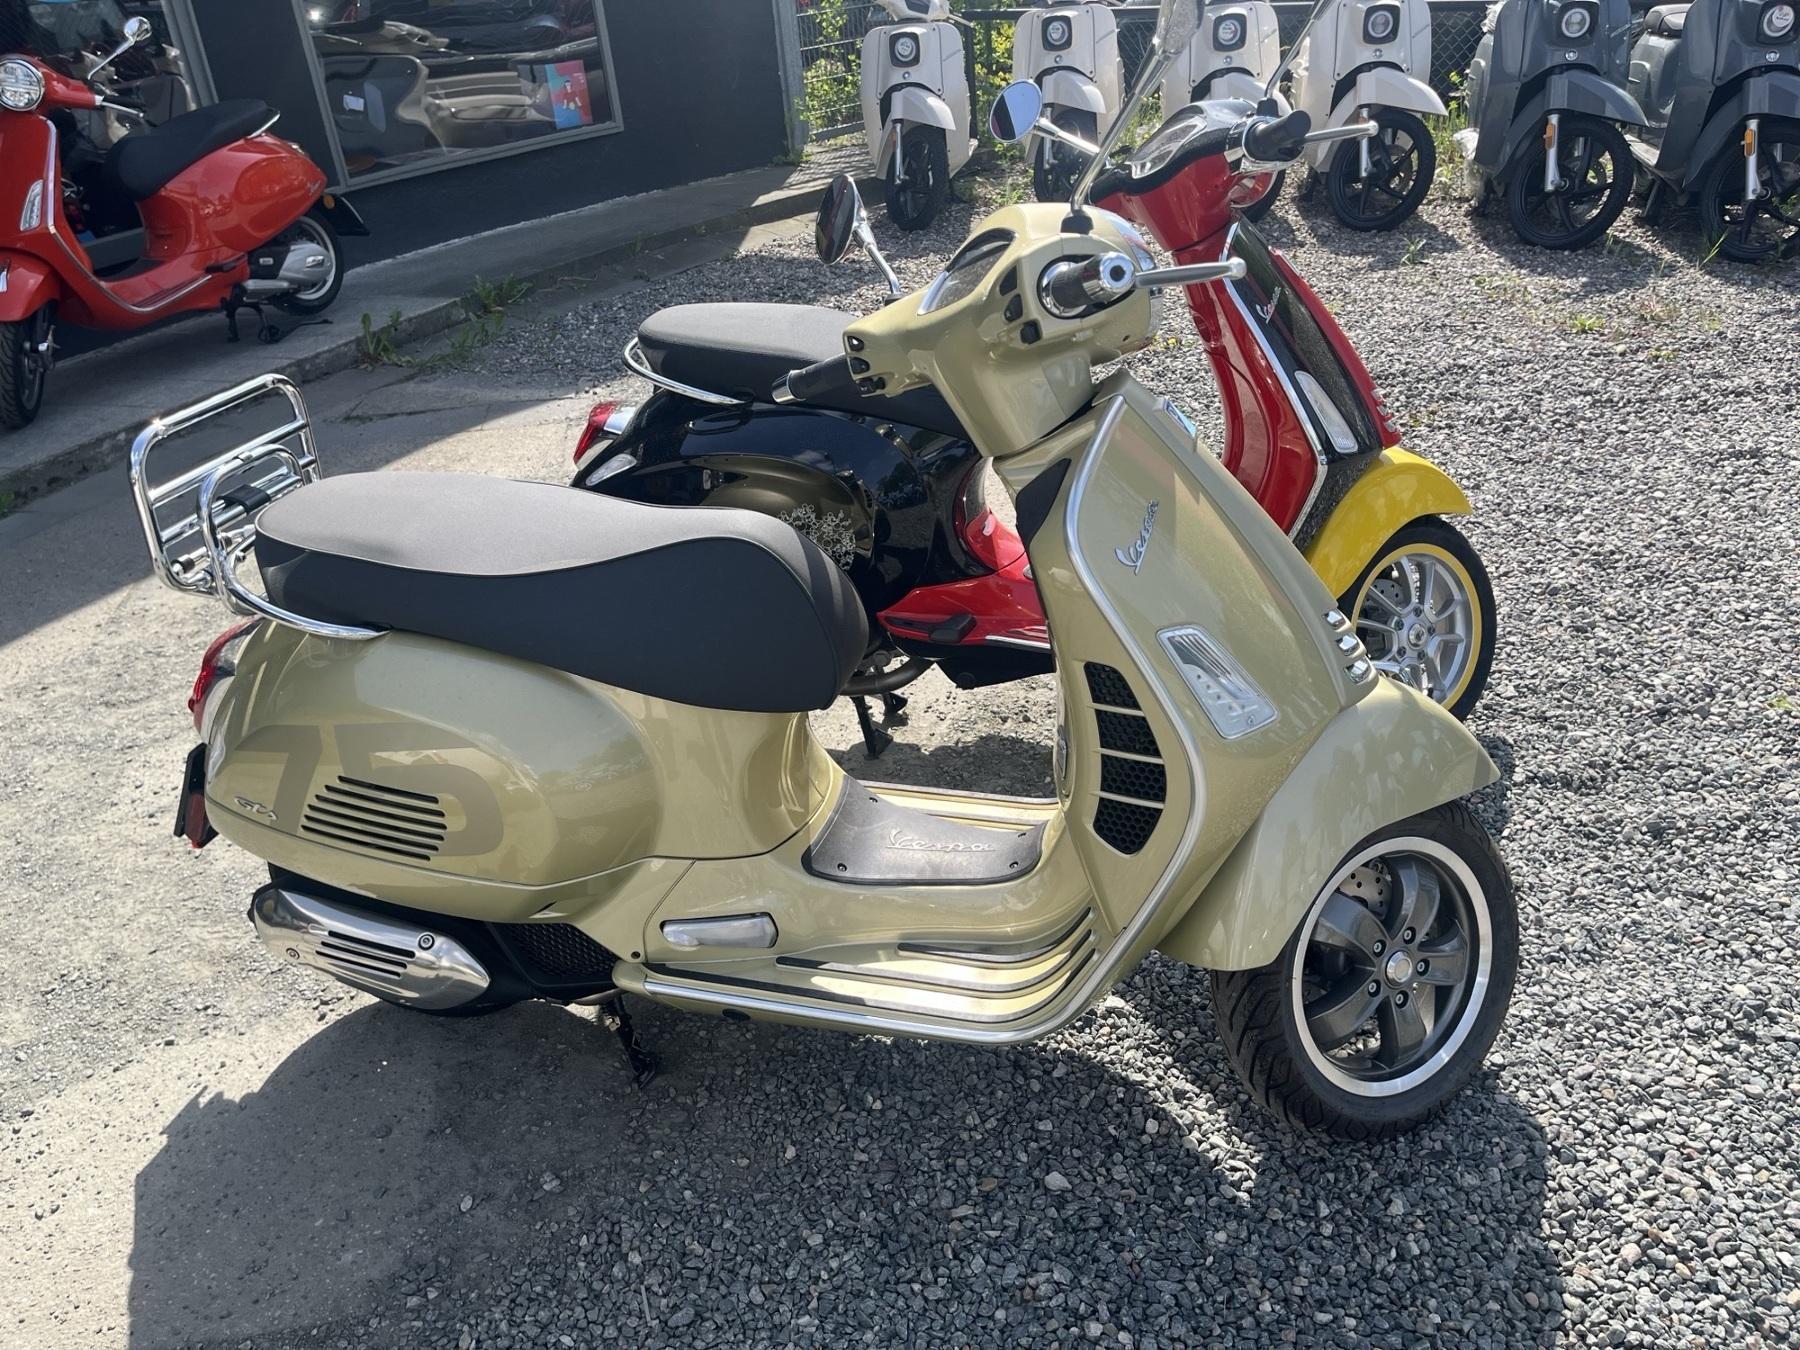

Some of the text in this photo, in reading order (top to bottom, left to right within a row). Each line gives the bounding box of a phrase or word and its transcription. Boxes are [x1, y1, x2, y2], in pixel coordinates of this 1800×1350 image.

[1115, 500, 1159, 576] Vespa
[230, 722, 504, 858] 75
[885, 828, 1000, 853] Vespa
